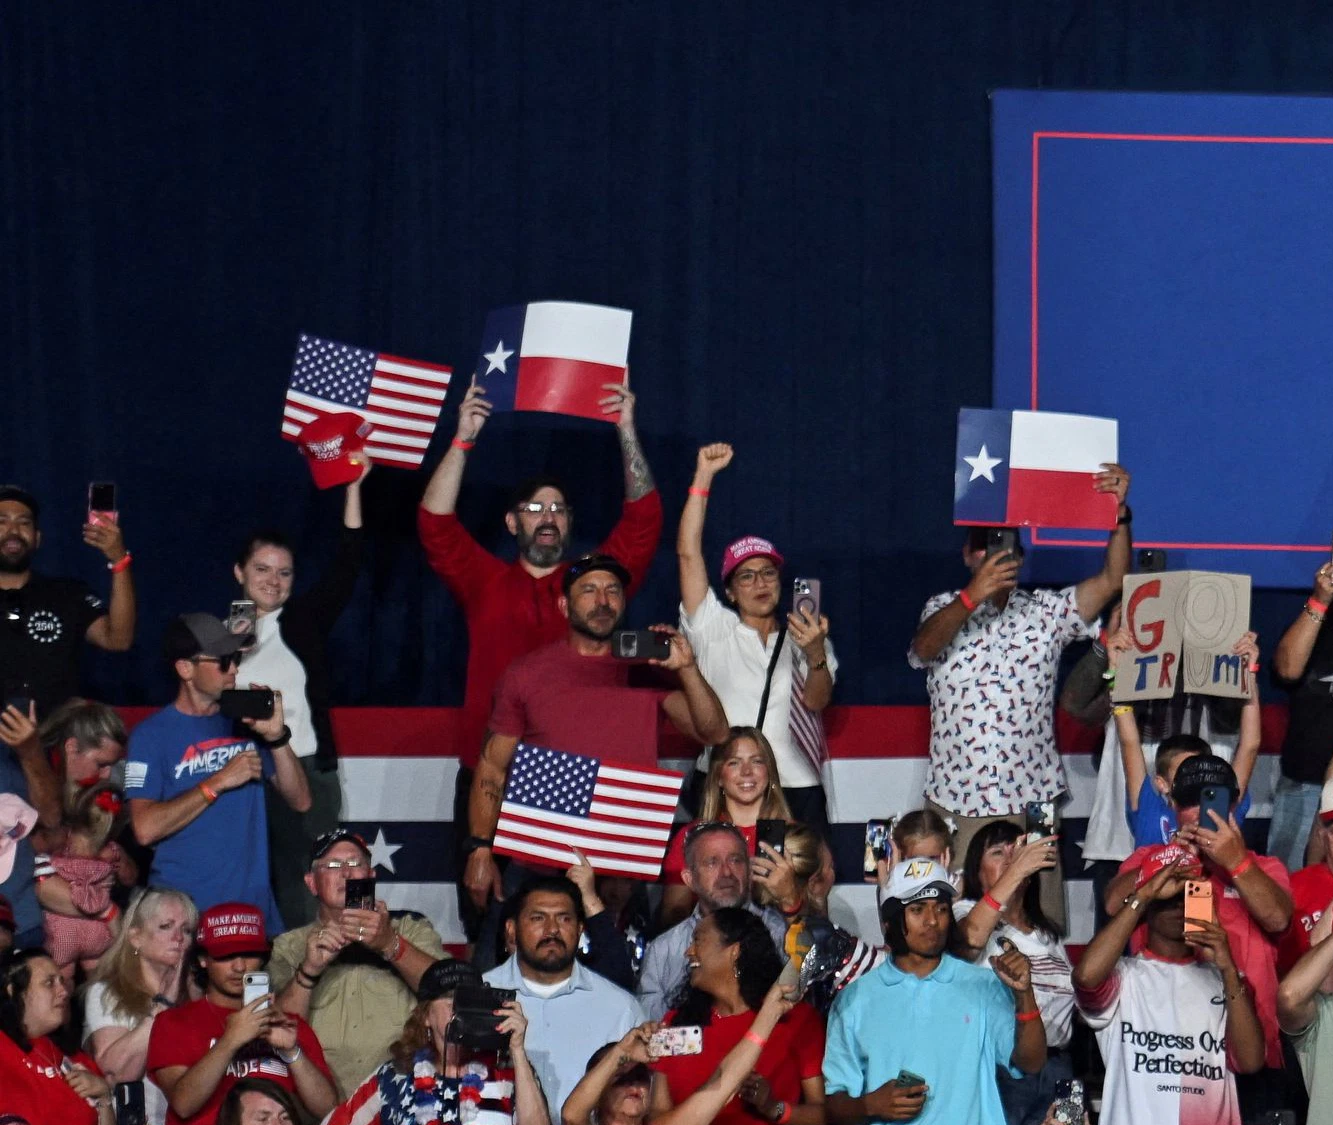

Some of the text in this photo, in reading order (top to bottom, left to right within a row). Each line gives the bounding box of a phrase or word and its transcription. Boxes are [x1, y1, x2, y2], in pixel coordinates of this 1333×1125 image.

[905, 862, 933, 880] 47
[207, 916, 230, 928] MAKE
[213, 926, 238, 938] GREAT
[1120, 1021, 1196, 1052] Progress
[1132, 1051, 1225, 1081] Perfection
[1156, 1084, 1181, 1094] SANTO
